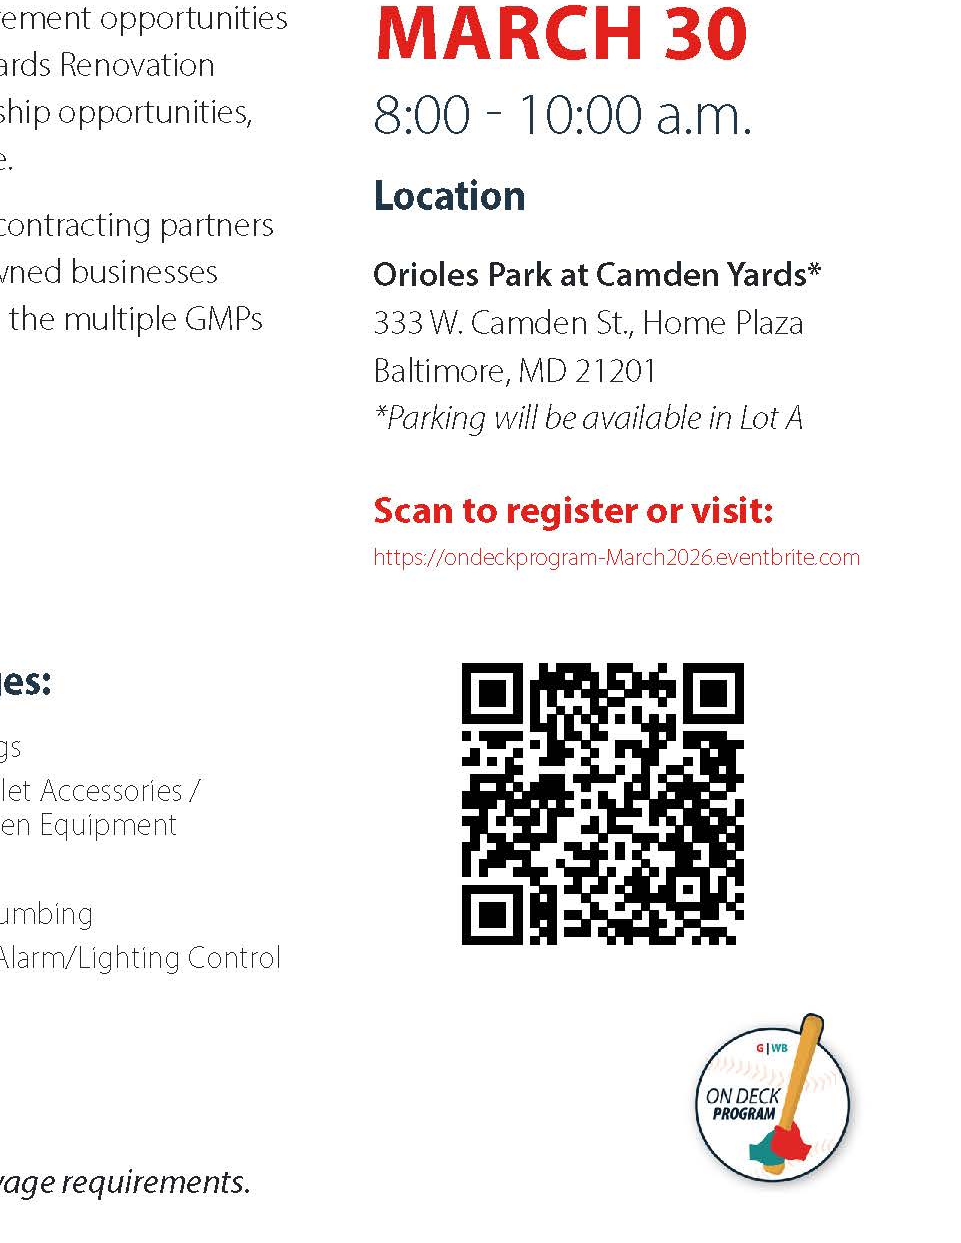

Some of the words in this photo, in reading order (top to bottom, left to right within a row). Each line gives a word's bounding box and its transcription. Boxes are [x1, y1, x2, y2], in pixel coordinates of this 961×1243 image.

[378, 5, 640, 60] MARCH
[665, 7, 746, 60] 30
[62, 52, 213, 76] Renovation
[375, 95, 469, 134] 8:00
[523, 95, 641, 134] 10:00
[658, 104, 750, 134] a.m.
[376, 179, 524, 210] Location
[73, 258, 217, 283] businesses
[374, 261, 478, 286] Orioles
[490, 261, 552, 286] Park
[561, 264, 588, 286] at
[597, 261, 718, 286] Camden
[375, 311, 422, 334] 333
[430, 310, 462, 334] W.
[472, 309, 586, 334] Camden
[598, 310, 633, 339] St.,
[645, 310, 725, 334] Home
[738, 309, 802, 334] Plaza
[376, 357, 510, 387] Baltimore,
[520, 358, 566, 382] MD
[576, 359, 652, 382] 21201
[496, 404, 538, 429] will
[546, 404, 576, 429] be
[583, 404, 701, 429] available
[710, 406, 731, 429] in
[741, 405, 779, 429] Lot
[785, 405, 802, 429] A
[375, 497, 452, 523] Scan
[463, 499, 497, 523] to
[508, 496, 638, 531] register
[647, 504, 683, 523] or
[691, 496, 772, 523] visit:
[375, 548, 859, 570] https://ondeckprogram-March2026.eventbrite.com
[706, 1088, 732, 1104] ON
[736, 1088, 782, 1104] DECK
[712, 1107, 776, 1120] PROGRAM
[62, 1169, 249, 1200] requirements.
